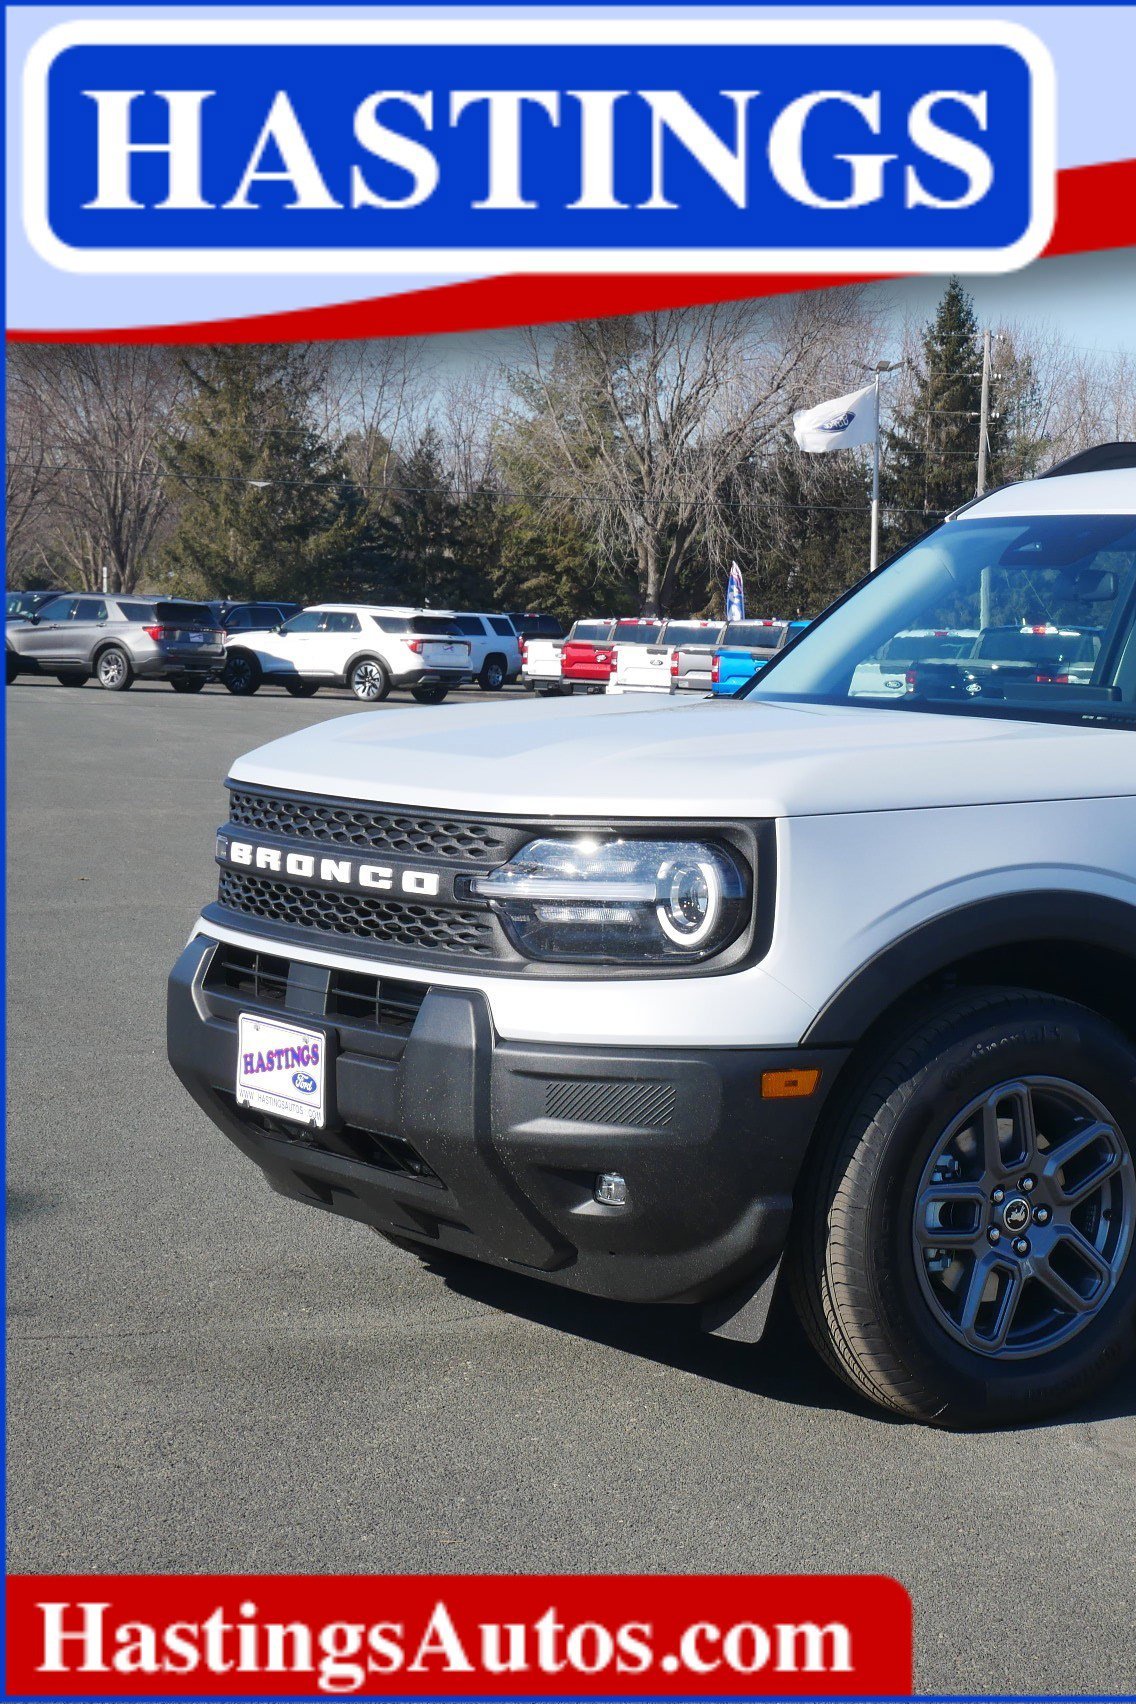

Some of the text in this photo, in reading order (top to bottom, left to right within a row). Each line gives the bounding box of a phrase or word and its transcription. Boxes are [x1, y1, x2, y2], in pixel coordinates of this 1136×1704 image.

[230, 841, 440, 896] BRONCO
[243, 1043, 319, 1074] HASTINGS
[295, 1073, 313, 1092] Ford
